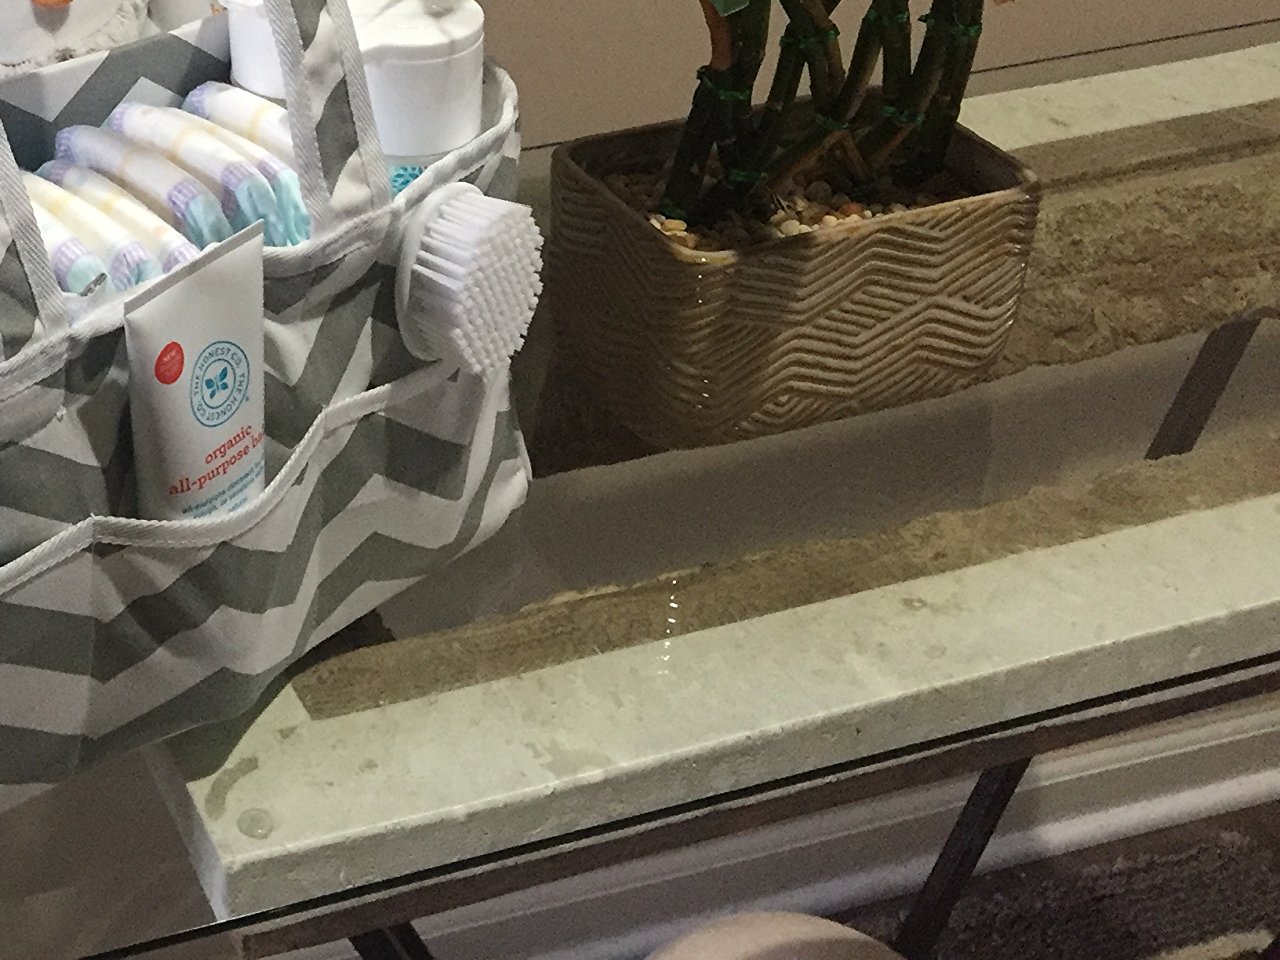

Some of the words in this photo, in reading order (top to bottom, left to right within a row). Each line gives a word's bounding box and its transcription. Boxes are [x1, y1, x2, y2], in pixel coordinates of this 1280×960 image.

[199, 347, 232, 372] HONEST
[235, 372, 245, 394] THE
[205, 396, 238, 422] HONEST
[205, 425, 252, 465] organic
[168, 445, 251, 495] all-purpose
